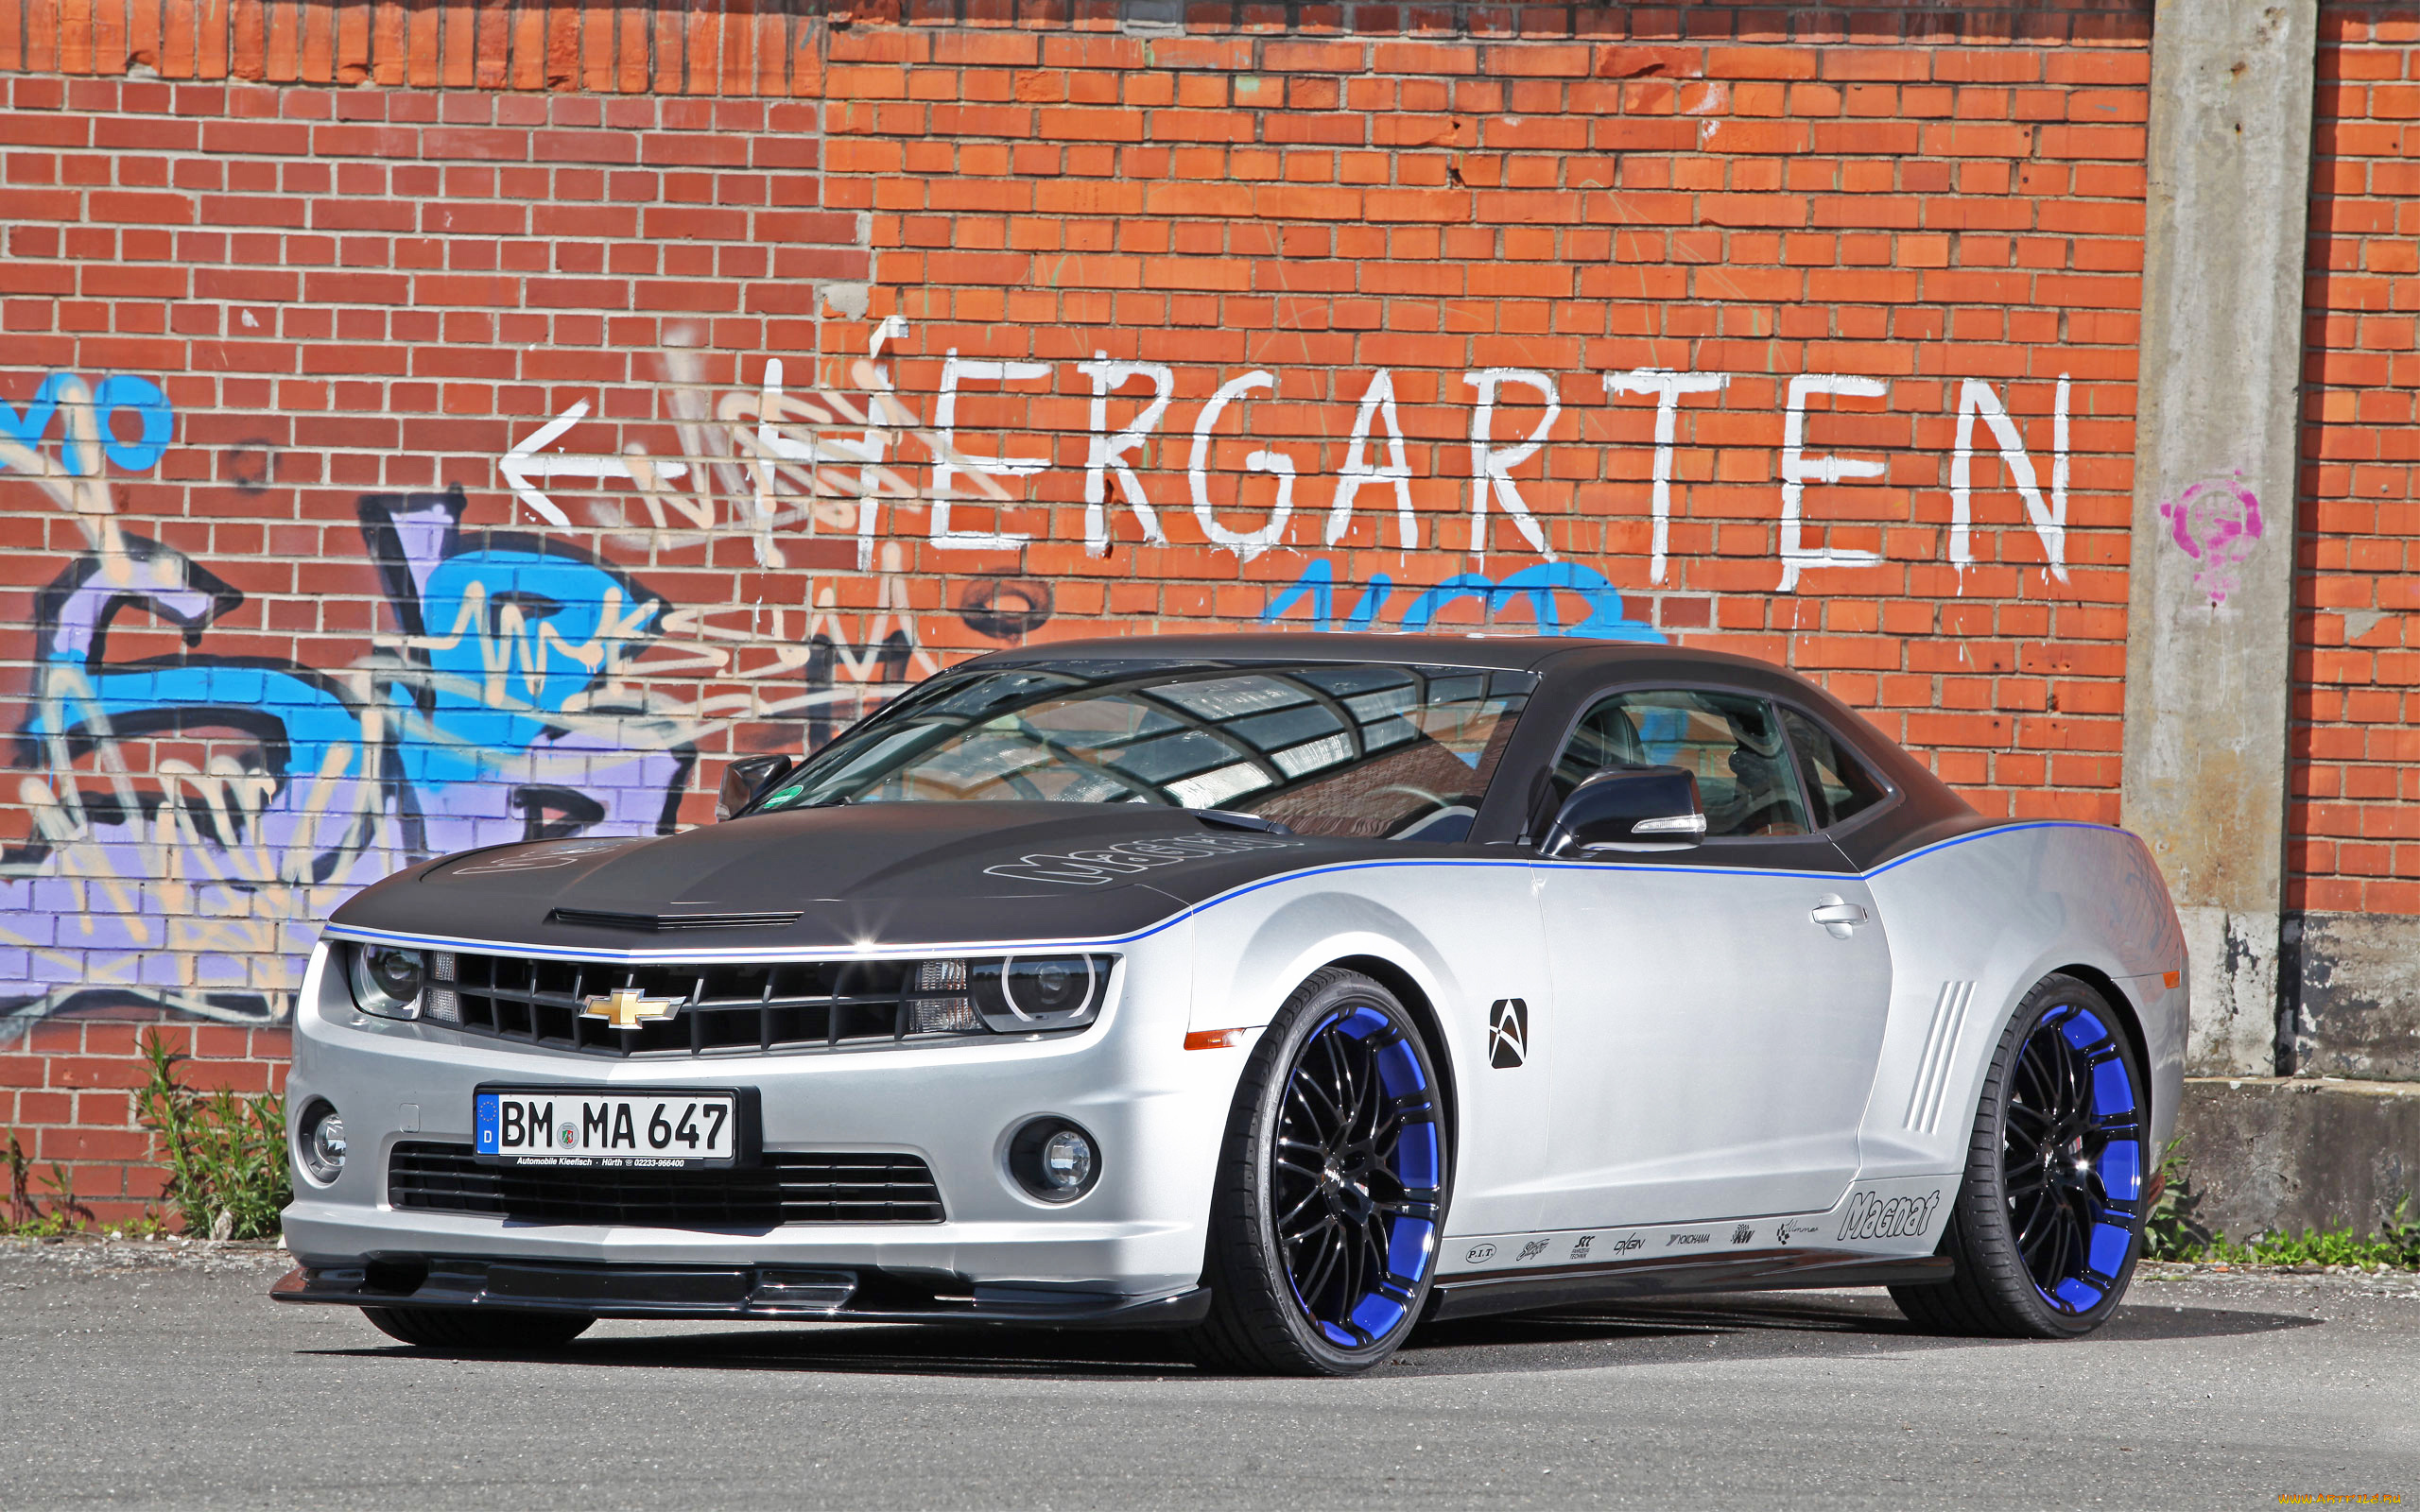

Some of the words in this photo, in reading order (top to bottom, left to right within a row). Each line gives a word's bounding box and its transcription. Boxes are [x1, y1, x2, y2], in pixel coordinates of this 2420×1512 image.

[483, 1130, 493, 1143] D
[501, 1101, 553, 1147] BM
[582, 1102, 636, 1149] MA
[648, 1103, 728, 1150] 647
[601, 1159, 623, 1167] Hürth
[633, 1159, 684, 1167] 02233-966400
[1837, 1190, 1940, 1242] Magnat
